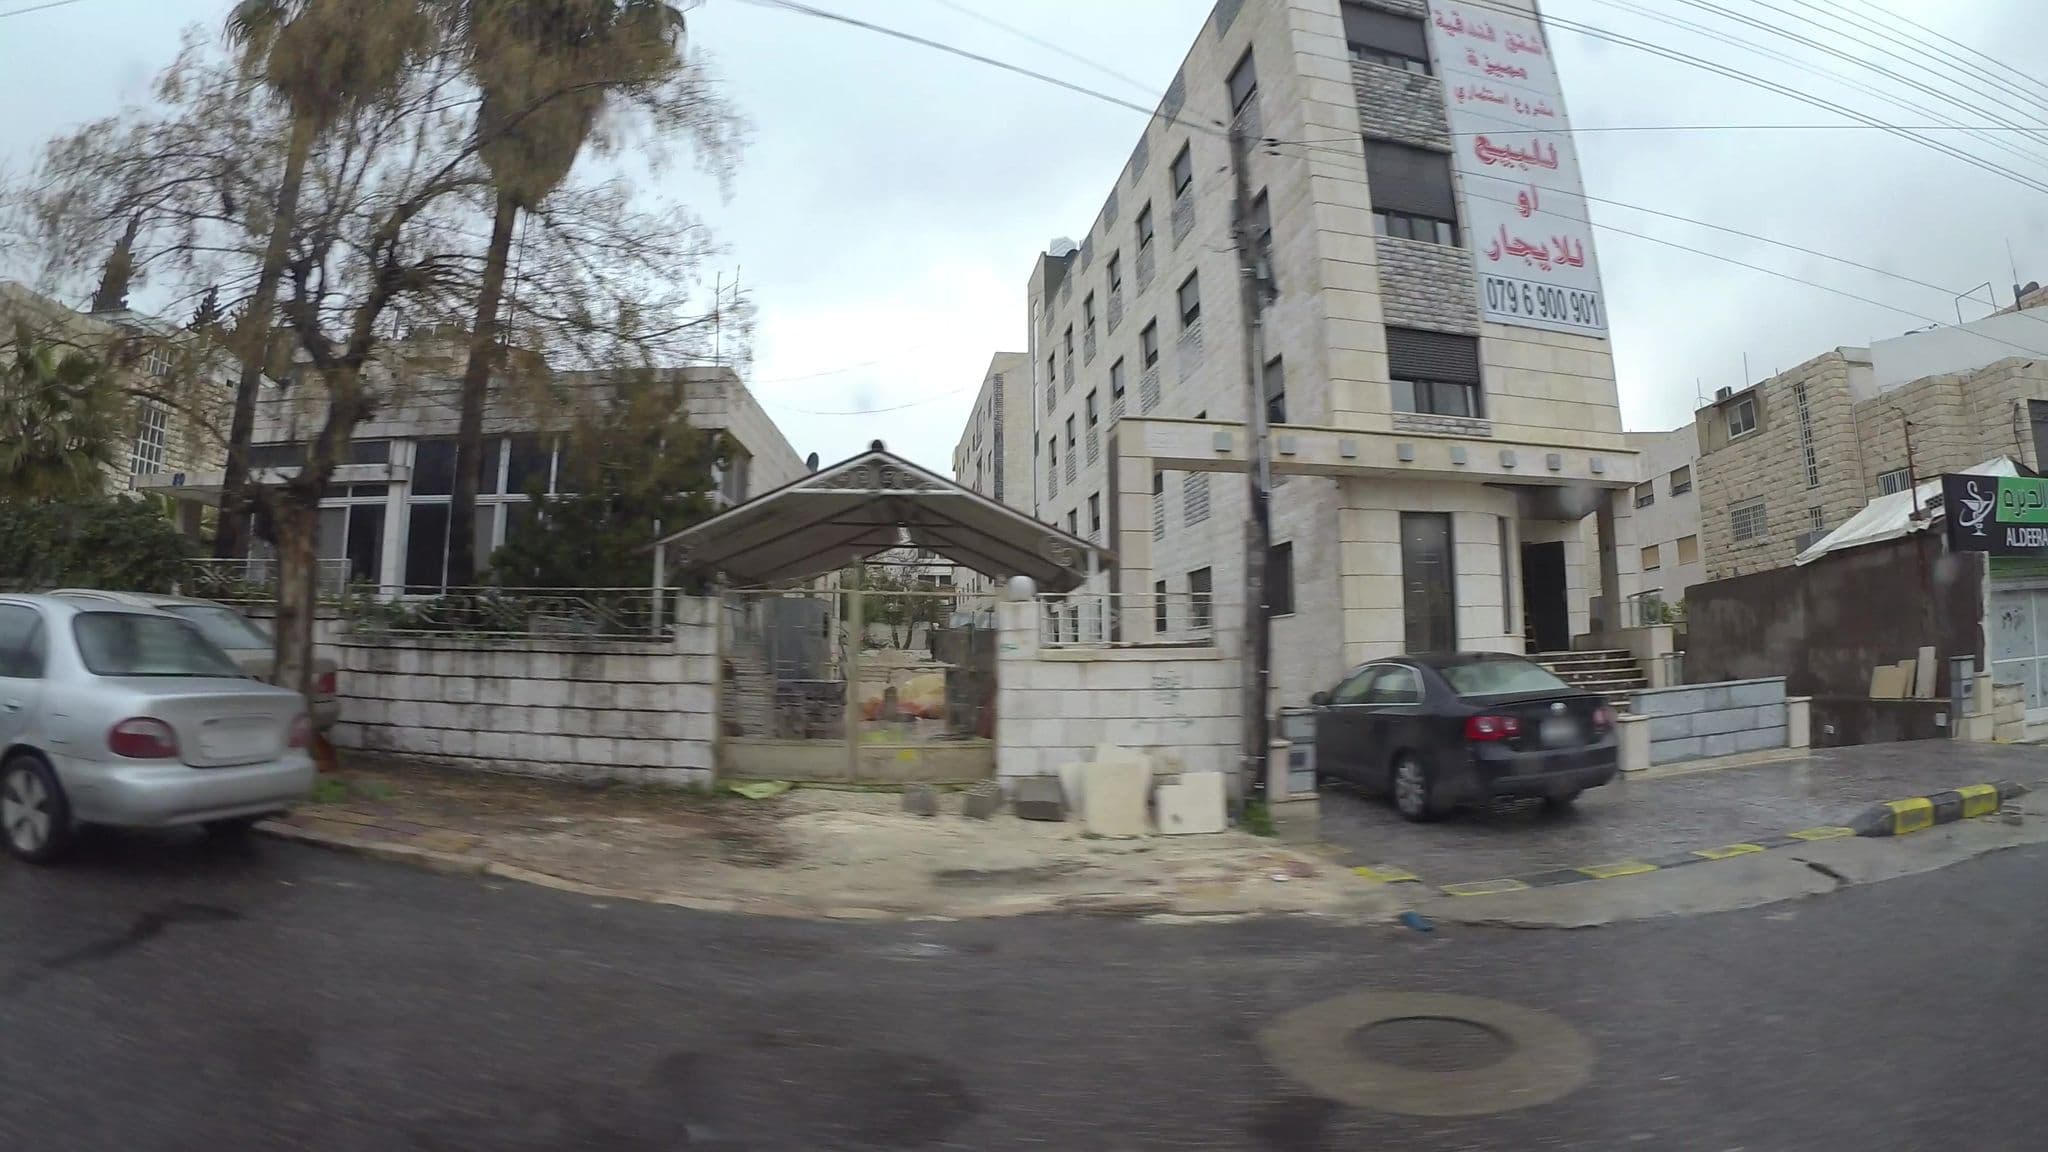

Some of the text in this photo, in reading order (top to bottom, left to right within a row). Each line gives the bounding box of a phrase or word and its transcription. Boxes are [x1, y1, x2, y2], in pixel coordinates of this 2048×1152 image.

[1514, 97, 1555, 117] مشروع
[1474, 135, 1558, 171] للبيع
[1483, 224, 1584, 271] للايجار
[1487, 277, 1599, 325] 079 6 900 901
